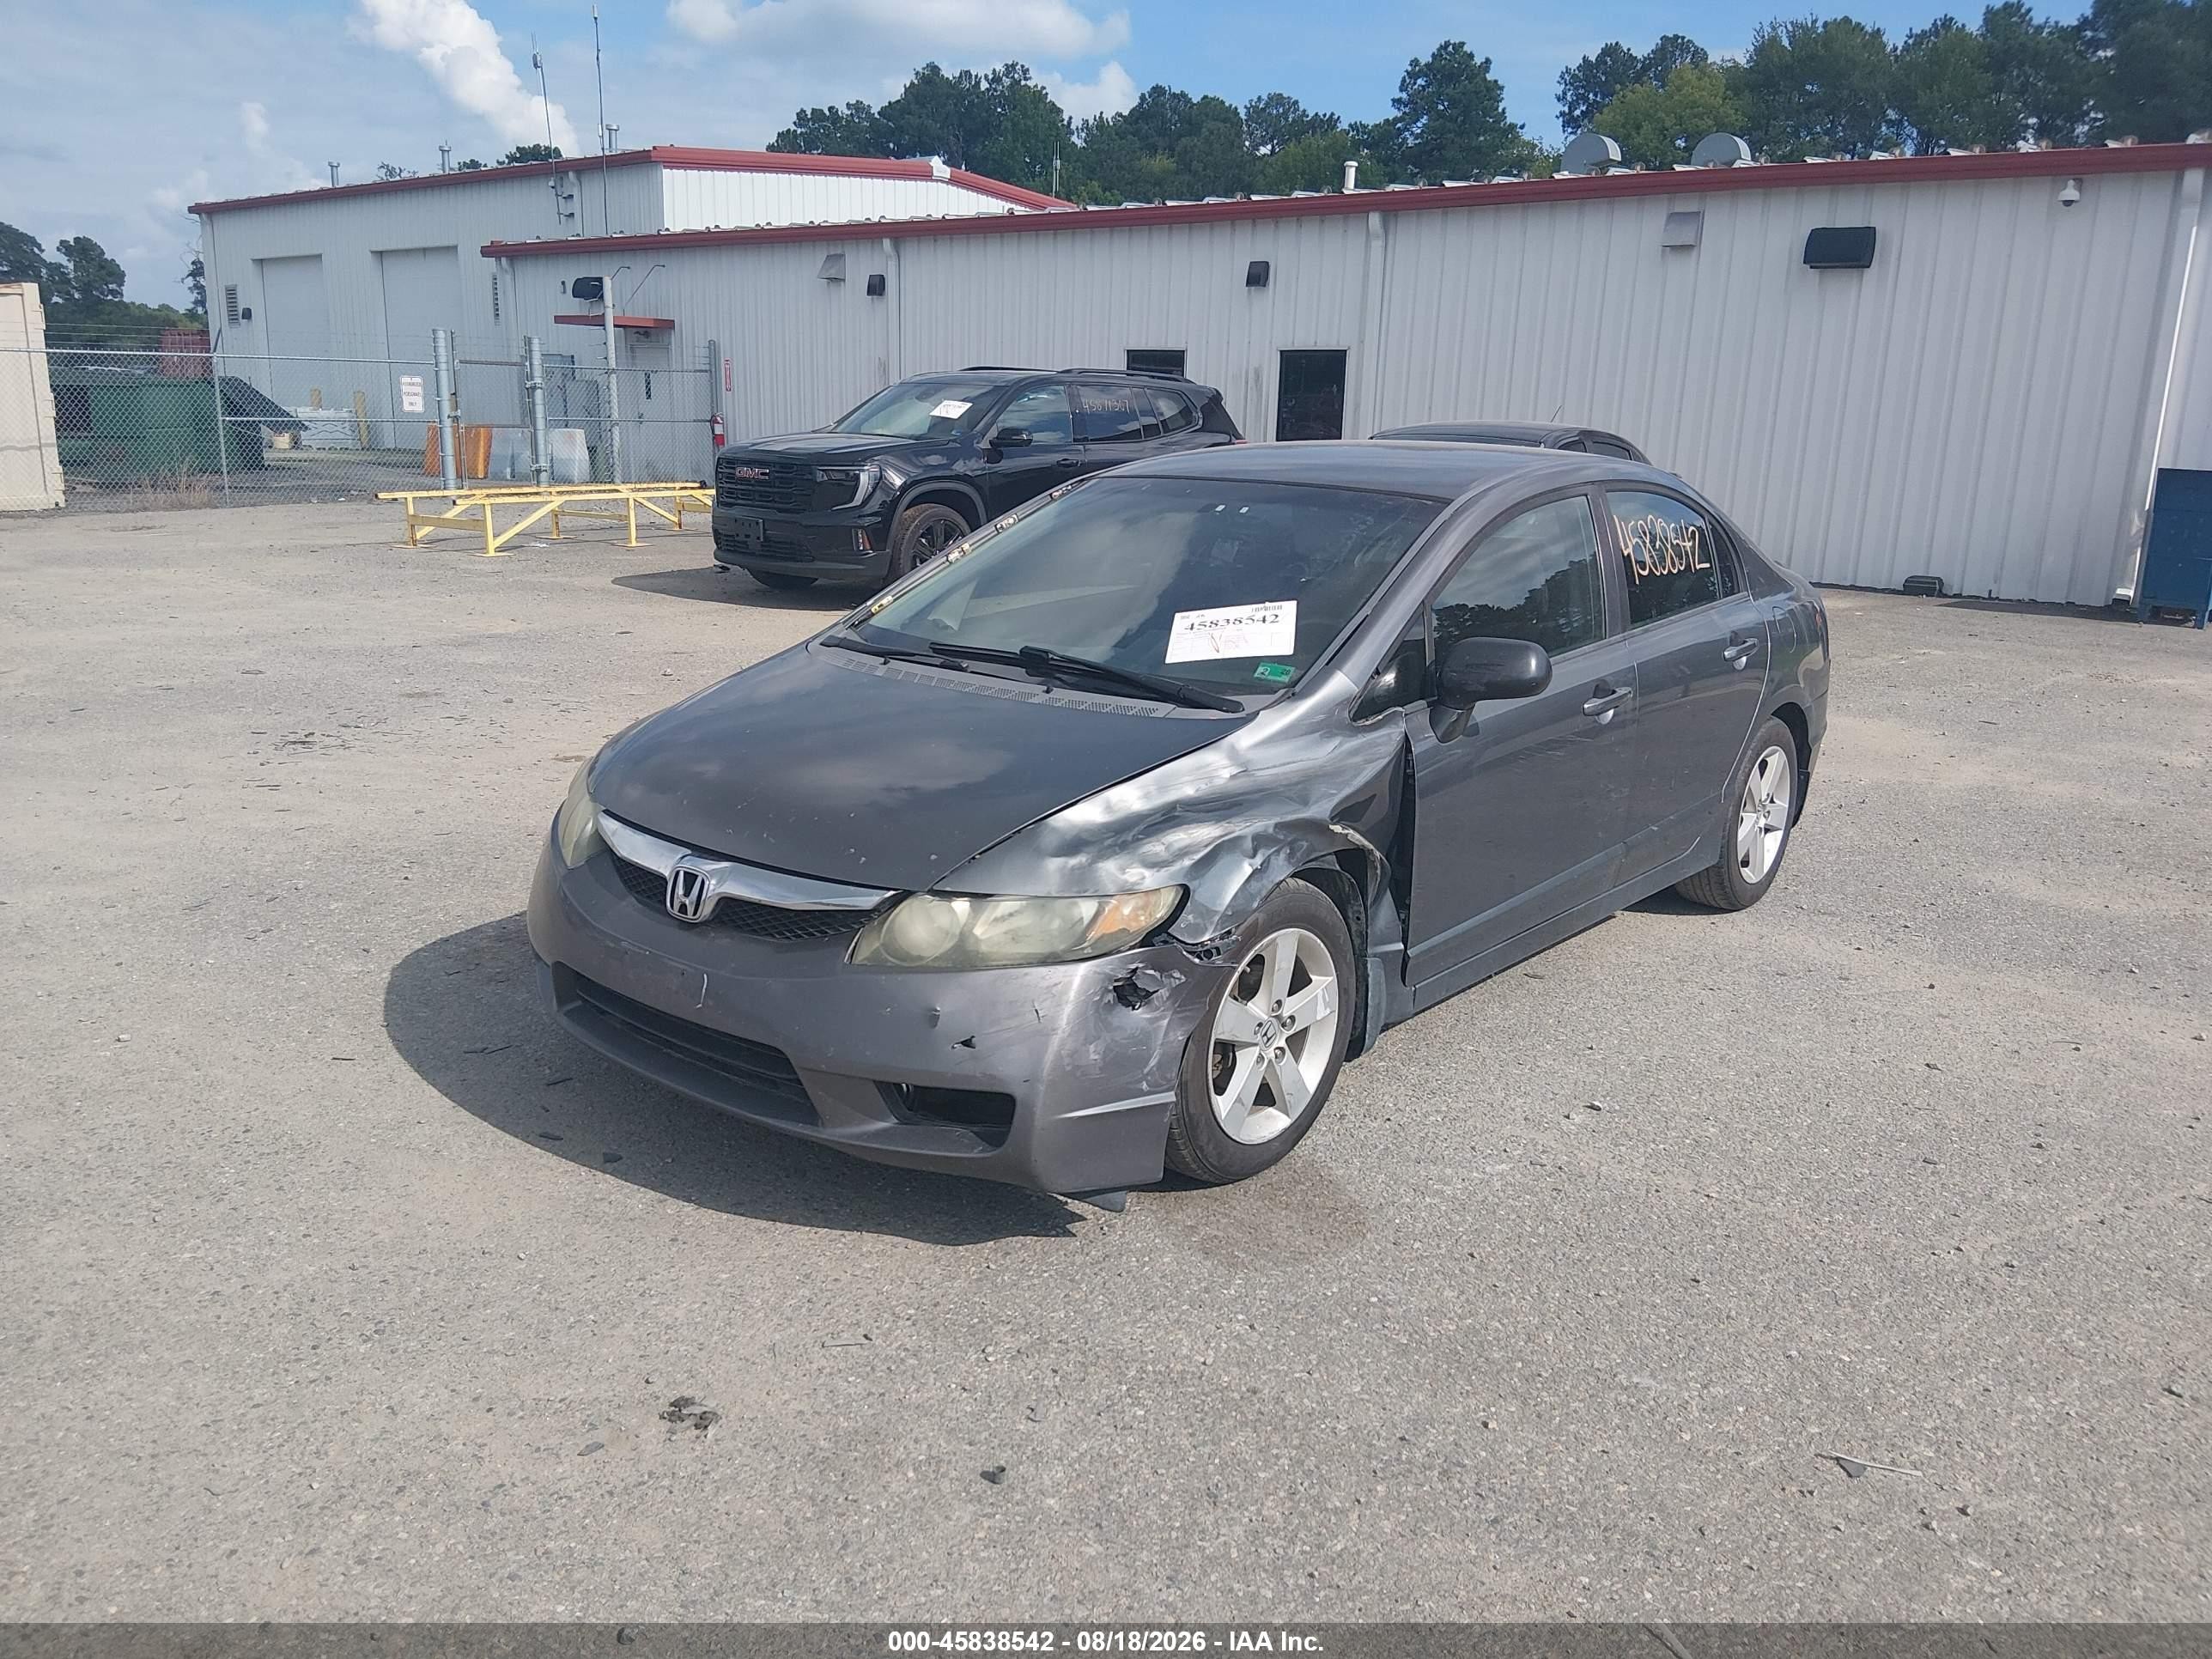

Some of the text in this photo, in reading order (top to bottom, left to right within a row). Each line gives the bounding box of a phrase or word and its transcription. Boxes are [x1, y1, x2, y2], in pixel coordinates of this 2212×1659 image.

[736, 466, 769, 479] GMC
[1613, 515, 1711, 585] 45838542
[1183, 613, 1280, 631] 45838542
